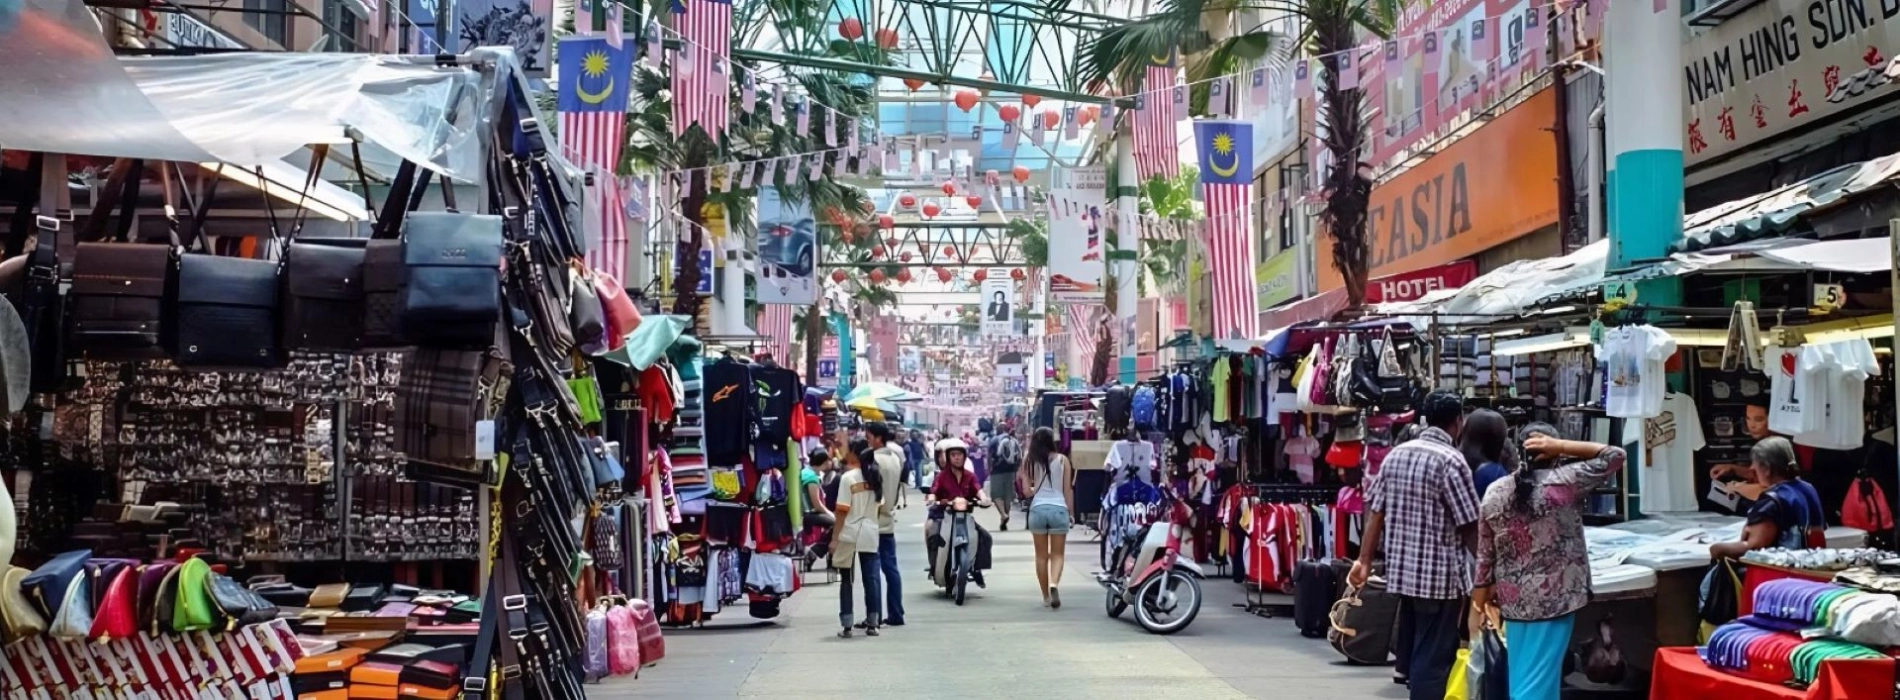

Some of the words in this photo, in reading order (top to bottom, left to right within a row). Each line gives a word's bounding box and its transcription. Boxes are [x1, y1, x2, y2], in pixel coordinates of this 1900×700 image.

[1685, 45, 1735, 105] NAM
[1739, 15, 1800, 81] HING
[1808, 0, 1875, 49] SDN.
[1380, 276, 1446, 300] HOTEL
[1616, 282, 1627, 299] 4
[1827, 286, 1837, 304] 5
